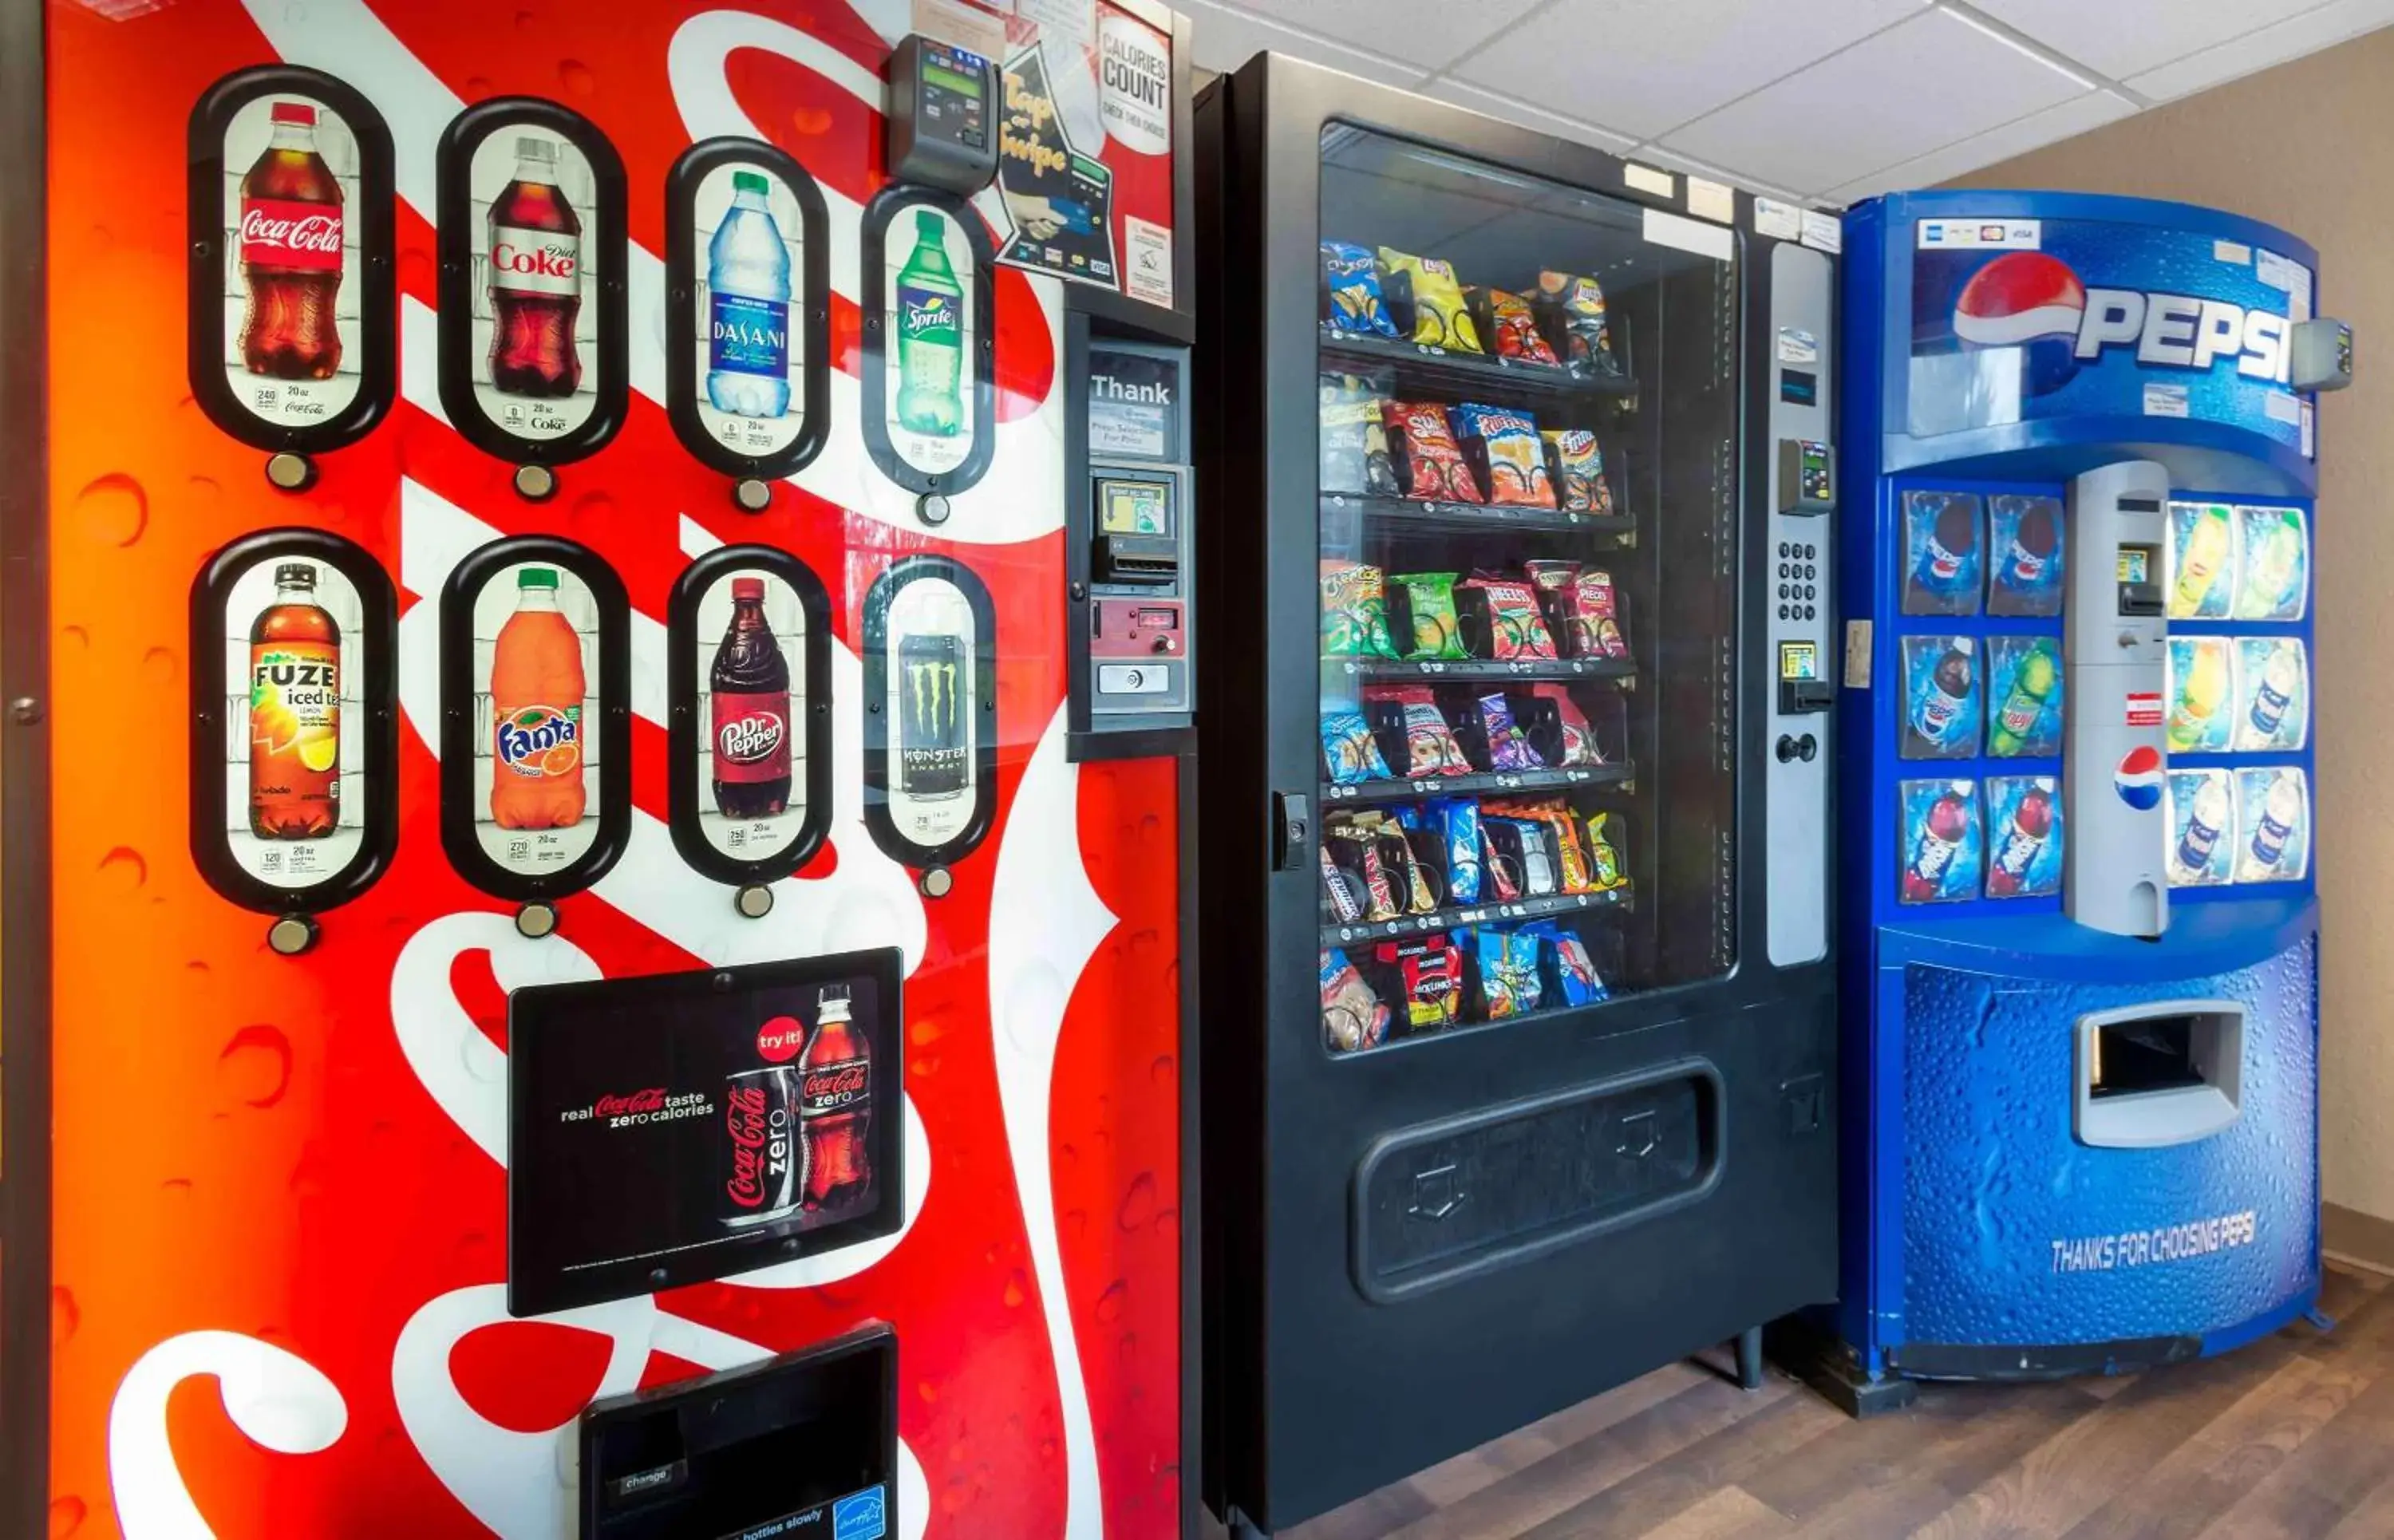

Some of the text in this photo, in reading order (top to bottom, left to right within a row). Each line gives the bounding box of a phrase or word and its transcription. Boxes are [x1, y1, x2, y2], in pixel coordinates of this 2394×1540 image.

[1103, 33, 1166, 81] CALORIES
[1104, 56, 1166, 110] COUNT
[242, 209, 342, 254] Coca-Cola
[492, 243, 575, 278] Coke
[545, 243, 575, 259] Diet
[907, 308, 952, 330] Sprite
[714, 320, 785, 349] DASANI
[2075, 287, 2293, 385] PEPSI
[258, 390, 275, 400] 240
[287, 385, 299, 396] 20
[1090, 374, 1171, 405] Thank
[531, 417, 567, 430] Coke
[256, 665, 334, 687] FUZE
[288, 689, 323, 705] iced
[741, 717, 767, 737] Dr
[497, 715, 577, 764] Fanta
[725, 722, 780, 756] Pepper
[904, 747, 966, 763] MONSTER
[753, 823, 764, 832] 20
[293, 846, 305, 856] 20
[510, 842, 527, 851] 270
[265, 854, 281, 863] 120
[760, 1029, 802, 1049] try it!
[804, 1066, 867, 1099] Coca-Cola
[561, 1088, 705, 1122] real Coca-Cola taste
[815, 1091, 853, 1108] zero
[610, 1103, 714, 1128] zero calories
[727, 1085, 766, 1207] Coca-Cola
[768, 1108, 787, 1175] zero
[2052, 1235, 2115, 1273] THANKS
[2116, 1230, 2150, 1267] FOR
[2151, 1218, 2219, 1262] CHOOSING
[626, 1471, 666, 1488] change
[743, 1507, 823, 1540] bottles slowly
